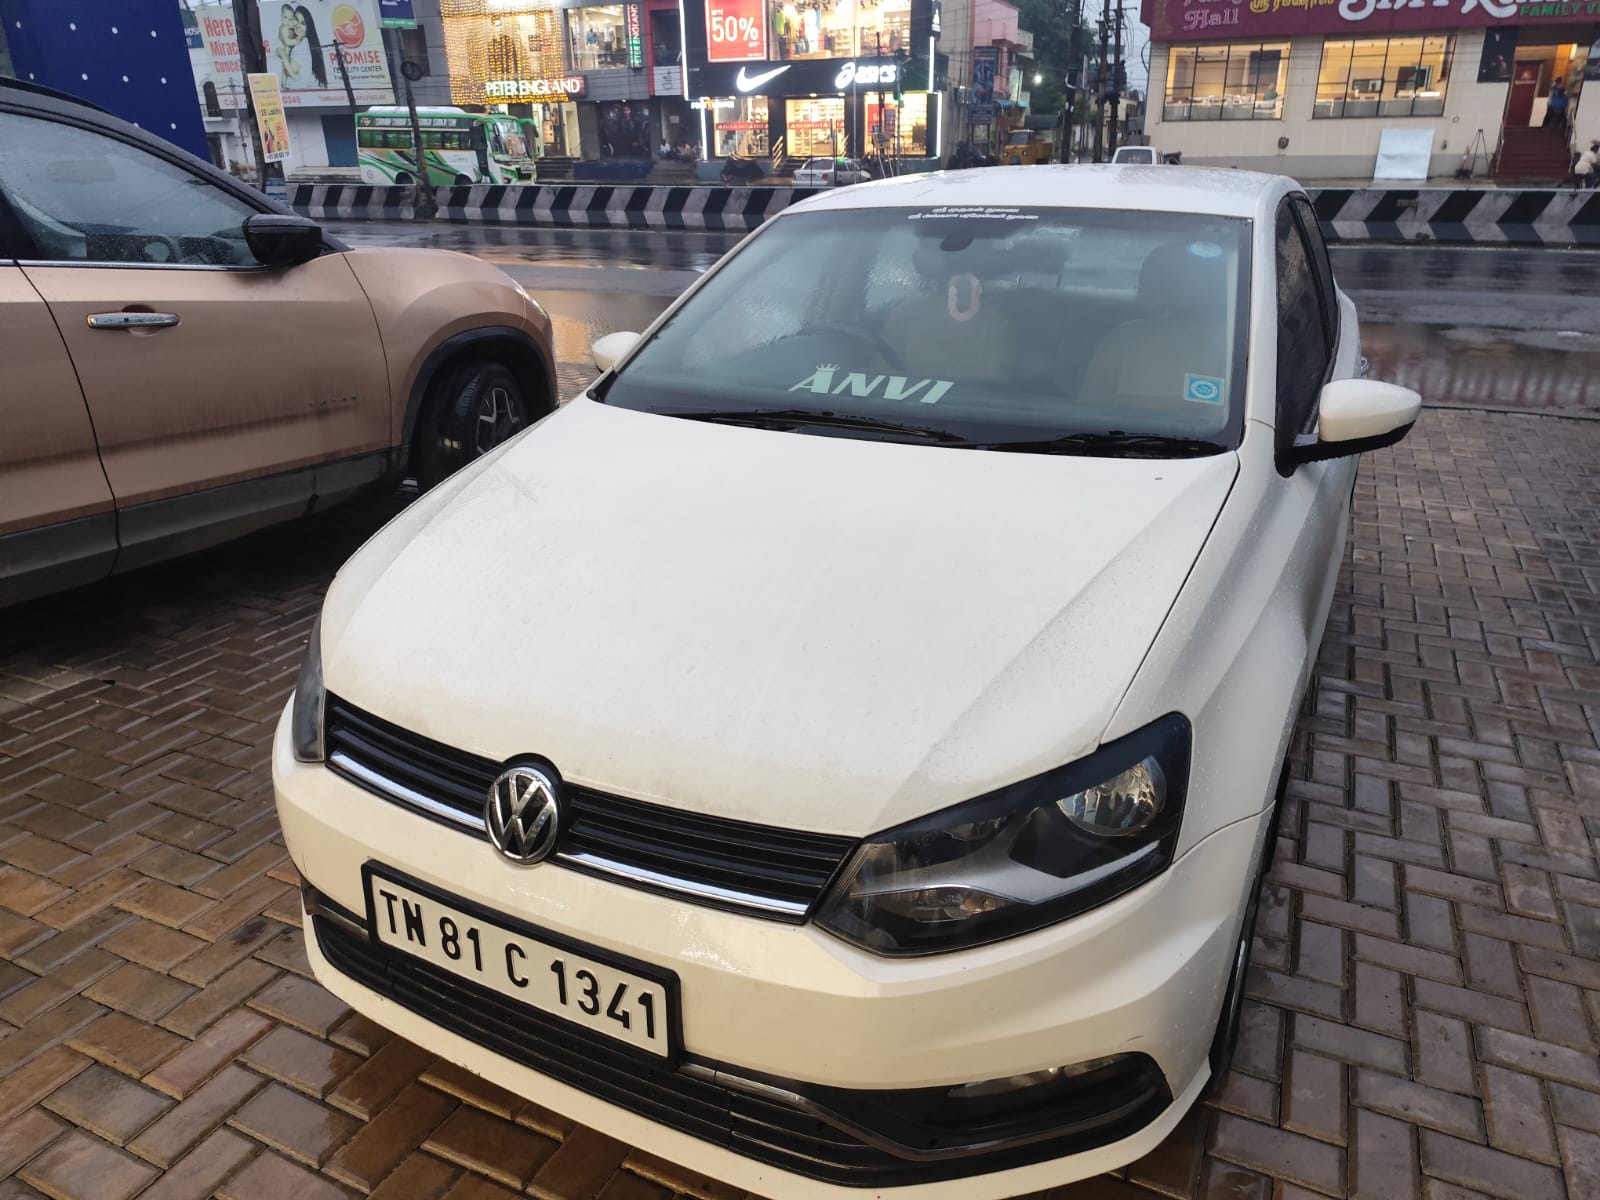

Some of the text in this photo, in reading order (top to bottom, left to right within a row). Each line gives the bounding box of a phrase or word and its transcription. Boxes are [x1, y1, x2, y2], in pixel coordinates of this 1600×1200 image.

[203, 17, 235, 37] Here
[630, 3, 641, 43] ENGLAND
[712, 16, 759, 42] 50%
[1183, 8, 1239, 31] Hall
[329, 50, 381, 64] POMISE
[486, 79, 580, 96] PETER ENGLAND
[787, 369, 955, 404] ANVI
[379, 889, 655, 1041] TN 81 C 1341
